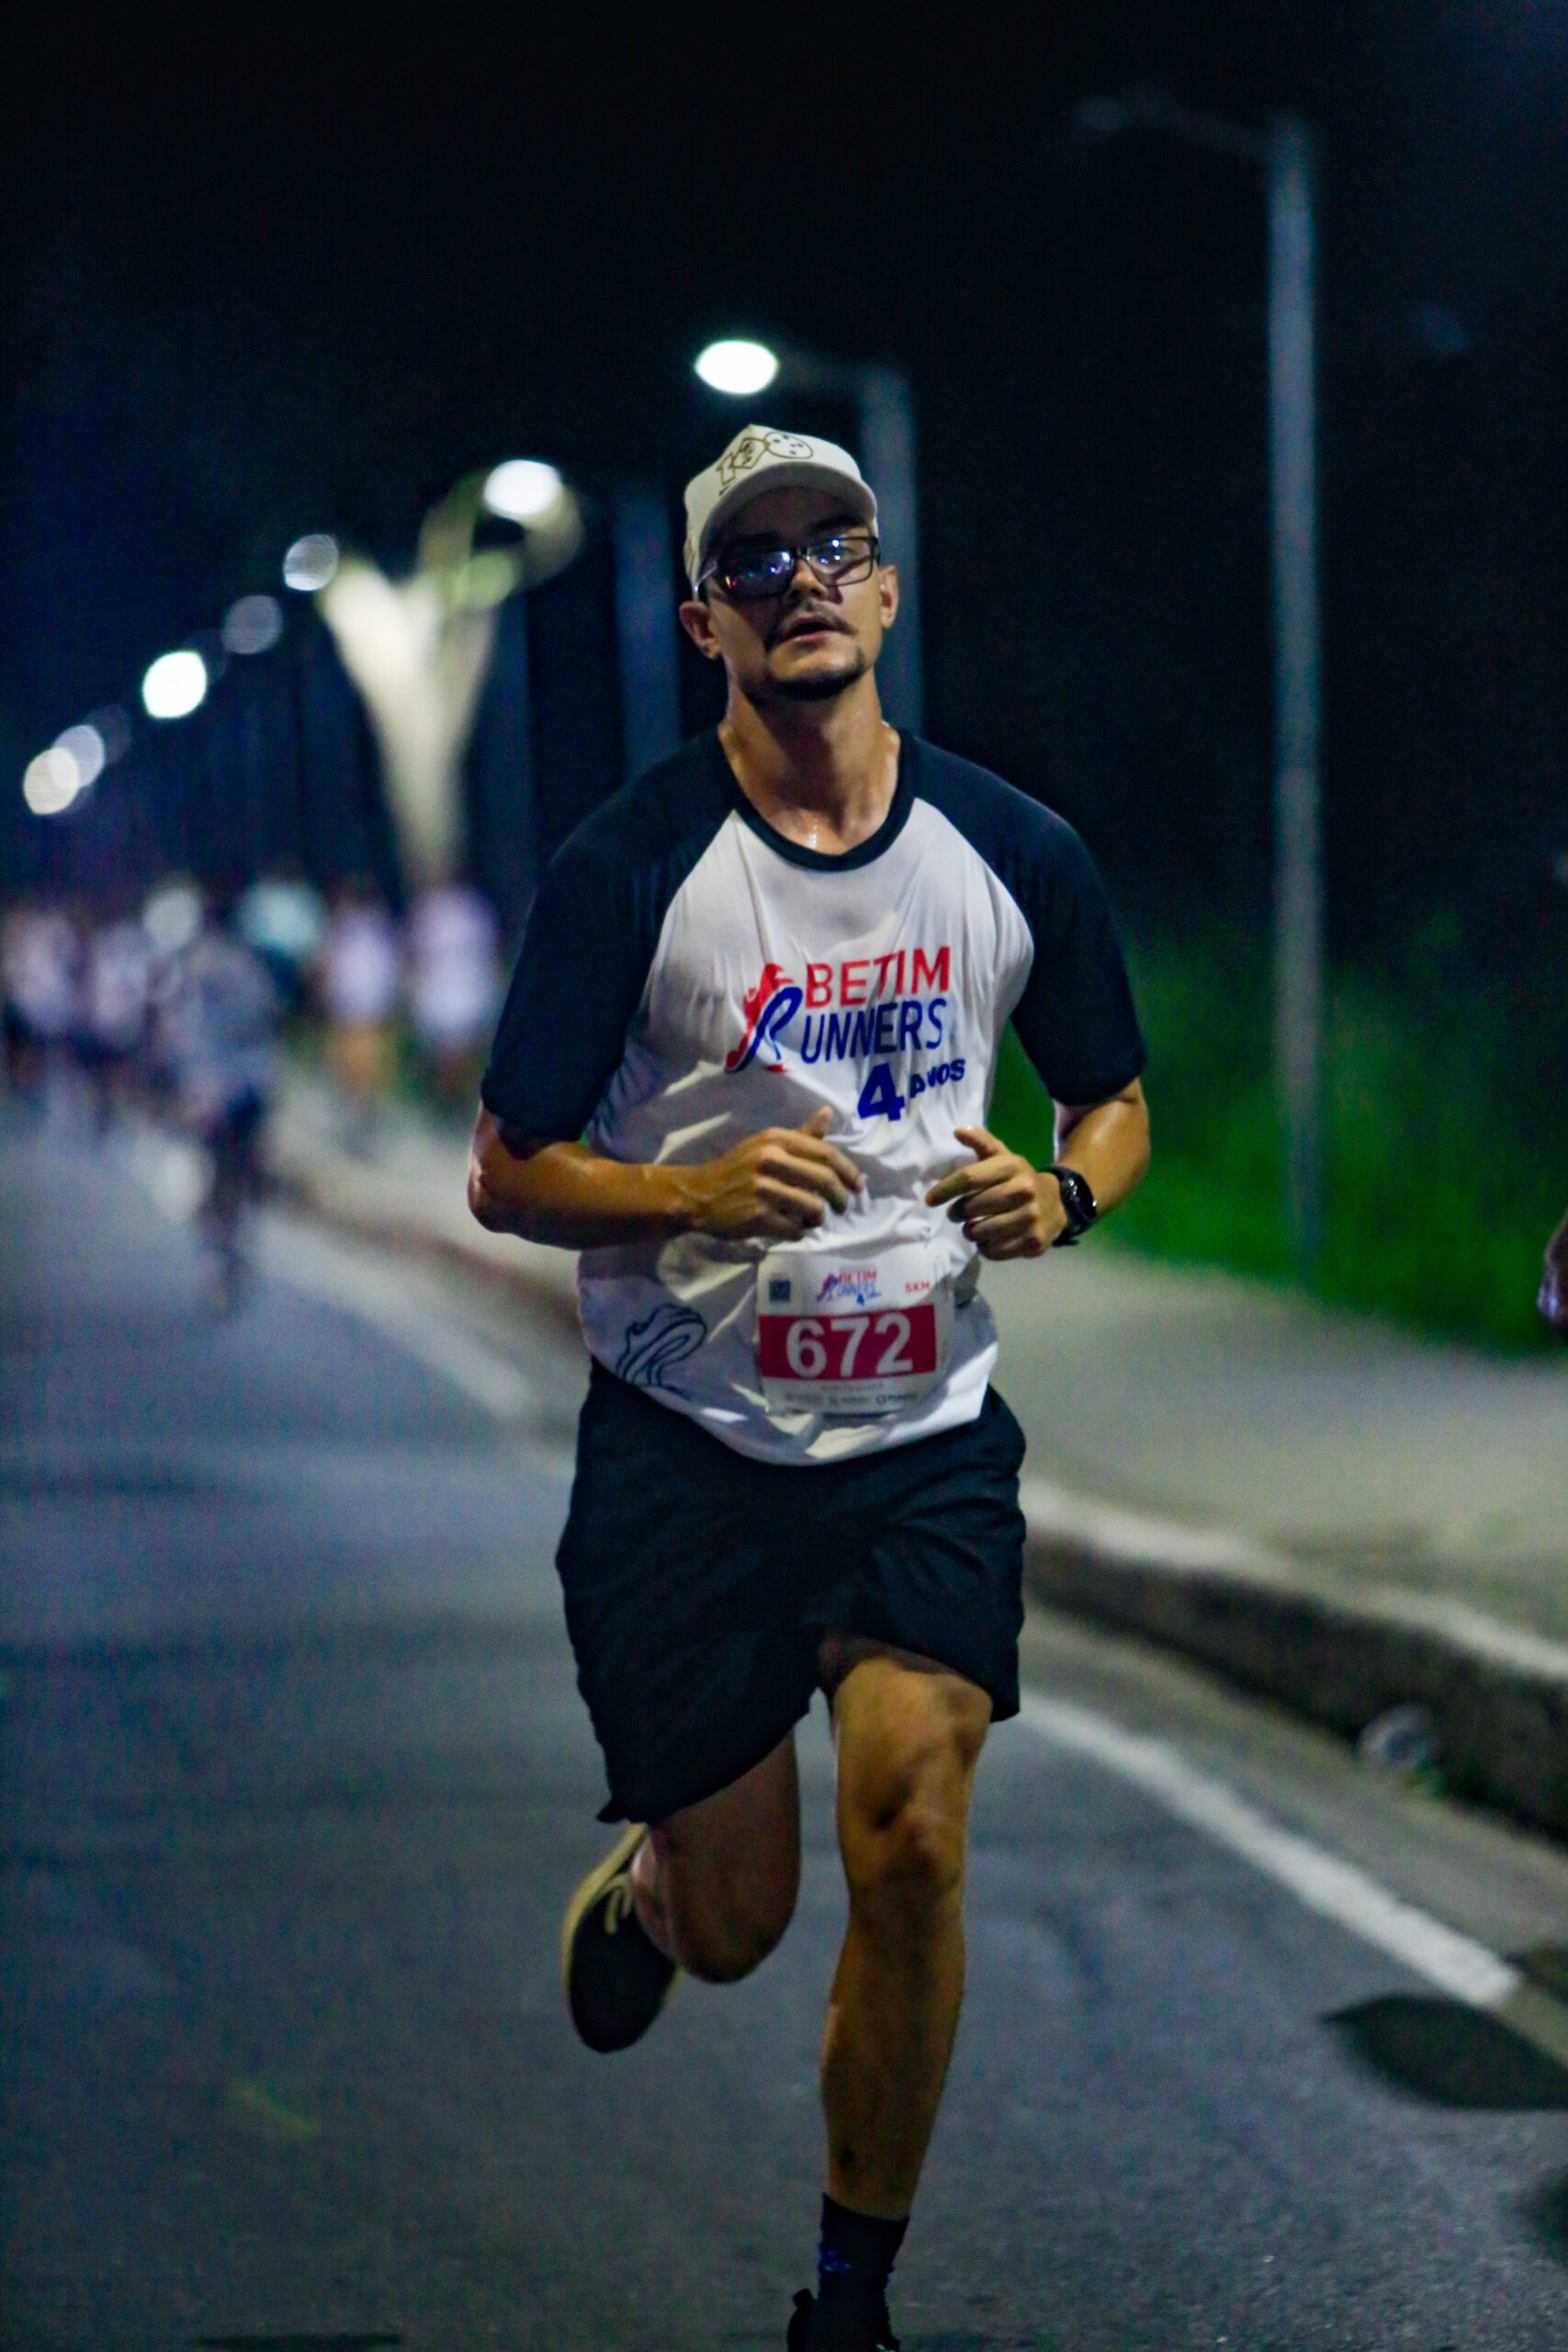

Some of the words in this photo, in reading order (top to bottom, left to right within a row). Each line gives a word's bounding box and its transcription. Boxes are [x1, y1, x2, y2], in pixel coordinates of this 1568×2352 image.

[805, 945, 951, 1009] BETIM
[724, 986, 947, 1074] RUNNERS
[857, 1062, 905, 1122] 4
[785, 1311, 914, 1379] 672
